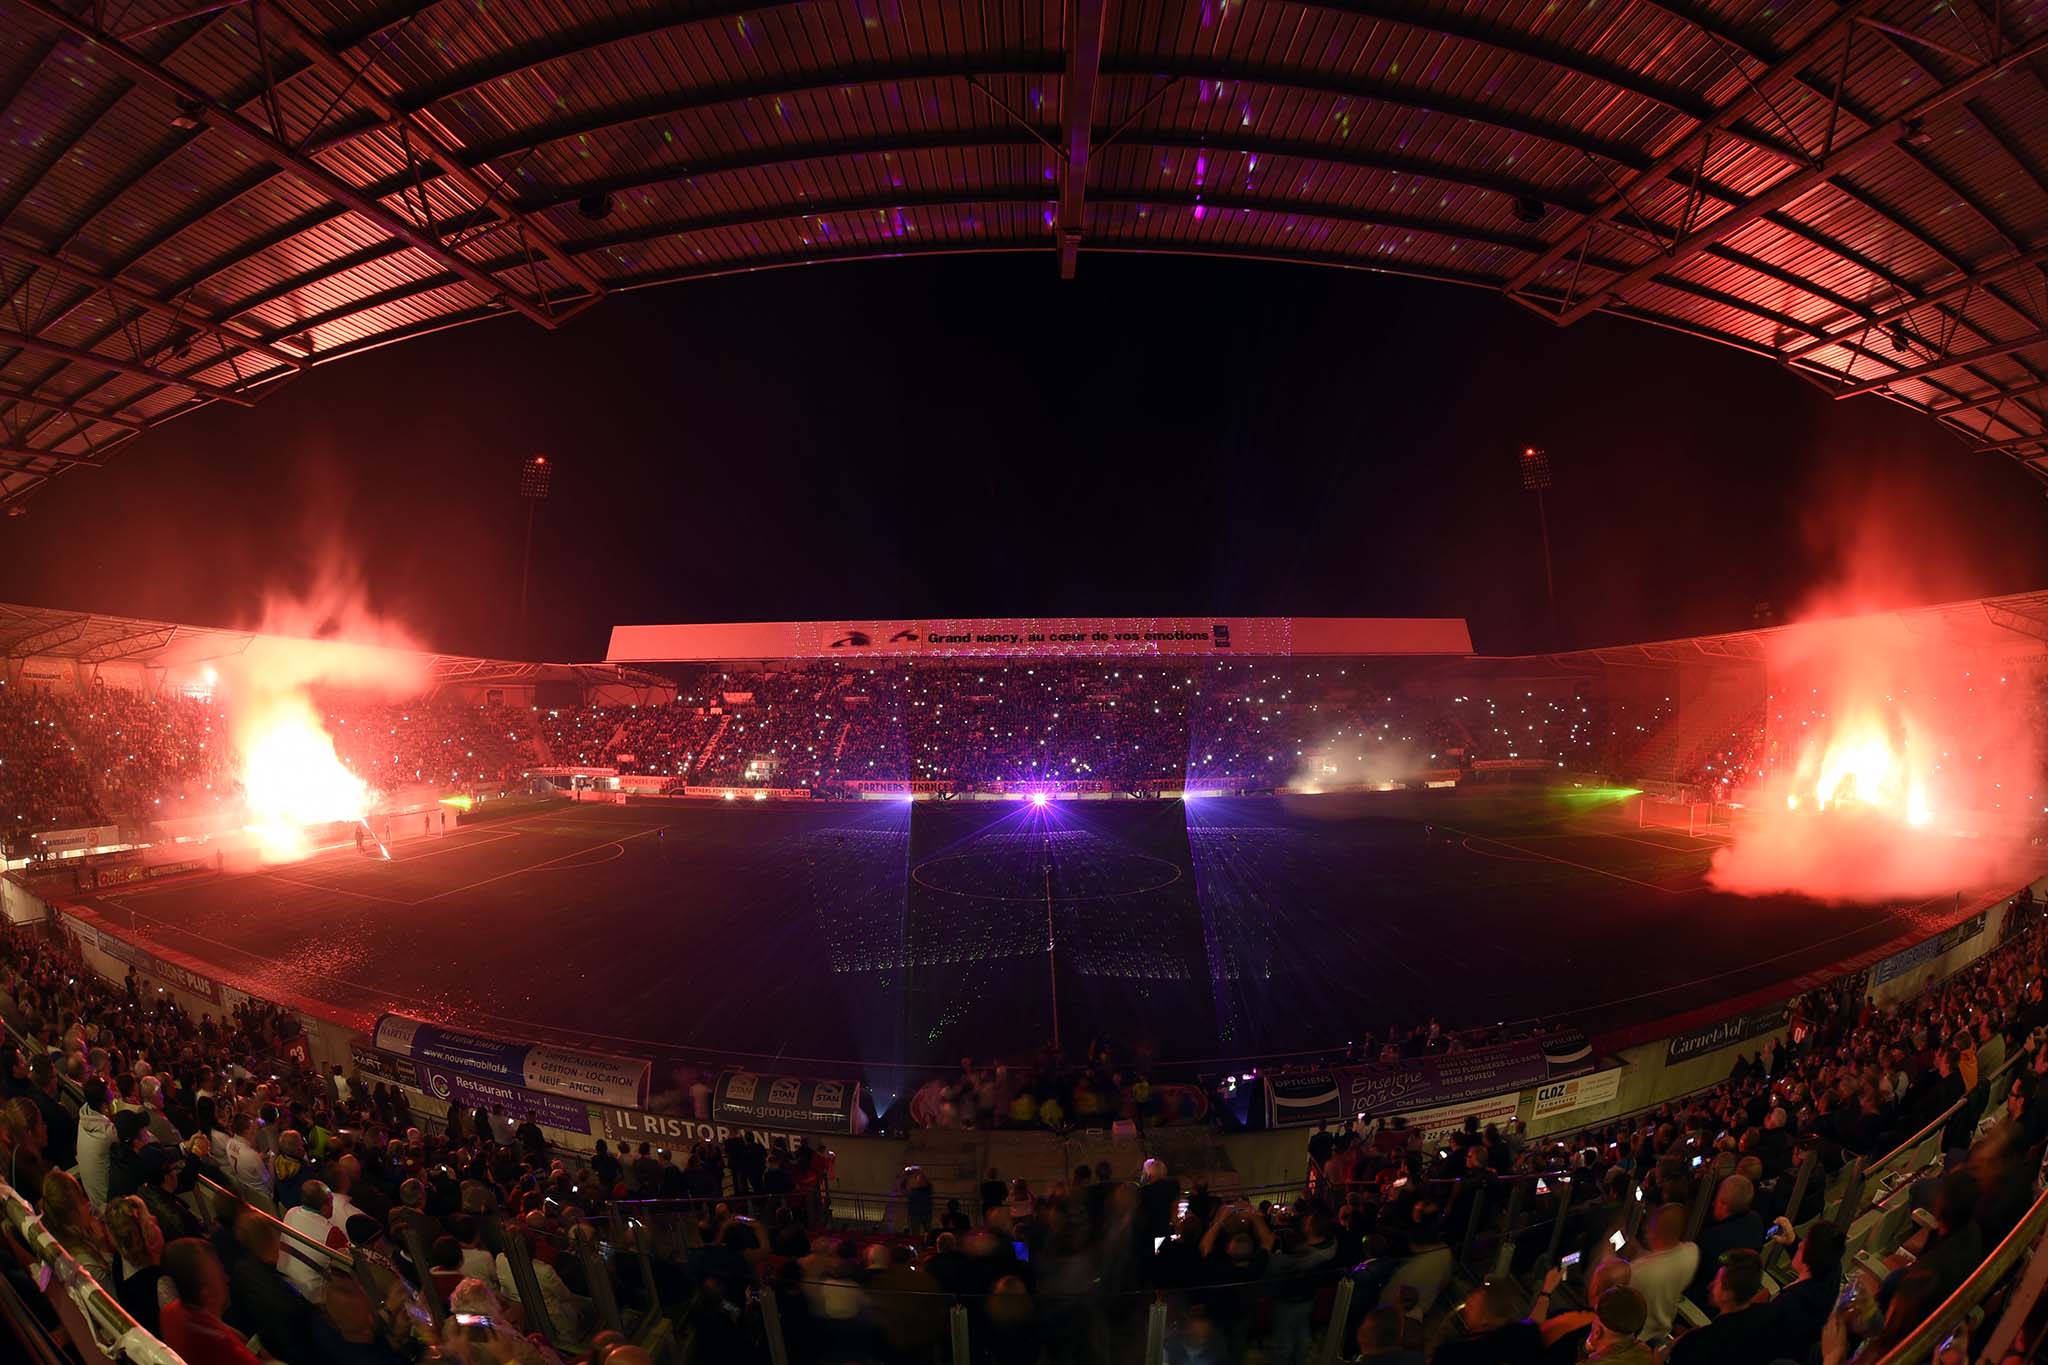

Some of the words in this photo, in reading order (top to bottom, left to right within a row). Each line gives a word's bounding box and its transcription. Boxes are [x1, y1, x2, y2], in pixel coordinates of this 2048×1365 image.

[928, 632, 972, 643] Grand
[1028, 632, 1045, 642] au
[1050, 631, 1087, 642] cœur
[1092, 631, 1109, 641] de
[1114, 631, 1140, 641] vos
[1143, 629, 1209, 641] émotions
[186, 972, 212, 996] PLUS
[541, 1062, 579, 1077] GESTION
[585, 1071, 633, 1087] LOCATION
[1275, 1075, 1332, 1089] OPTICIENS
[456, 1077, 515, 1100] Restaurant
[539, 1075, 560, 1087] NEUF
[569, 1082, 604, 1096] ANCIEN
[772, 1090, 796, 1099] STAN
[815, 1095, 839, 1103] STAN
[1352, 1094, 1388, 1112] 100%
[616, 1111, 638, 1131] IL
